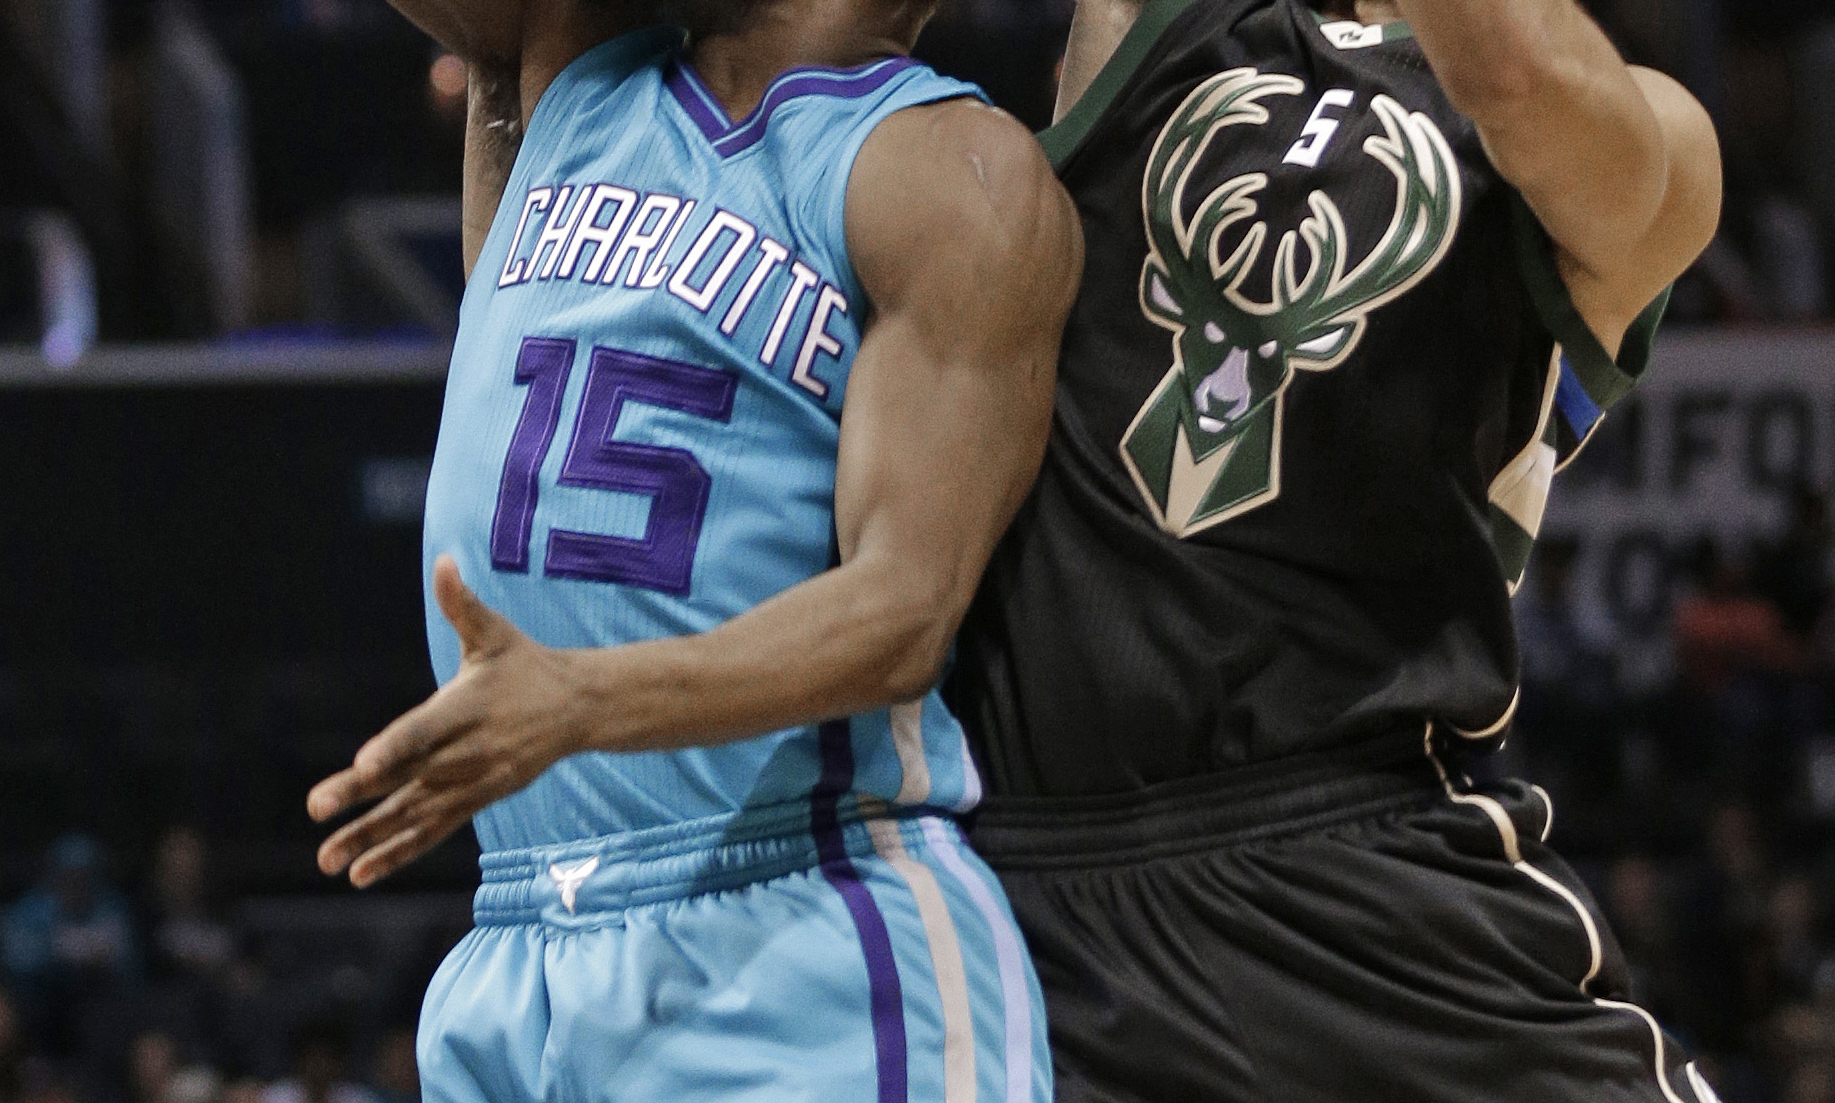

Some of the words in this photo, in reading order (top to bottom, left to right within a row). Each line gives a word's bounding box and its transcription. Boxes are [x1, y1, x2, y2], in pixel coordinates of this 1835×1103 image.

[1281, 88, 1355, 169] 5
[498, 183, 848, 398] CHARLOTTE
[490, 336, 740, 597] 15
